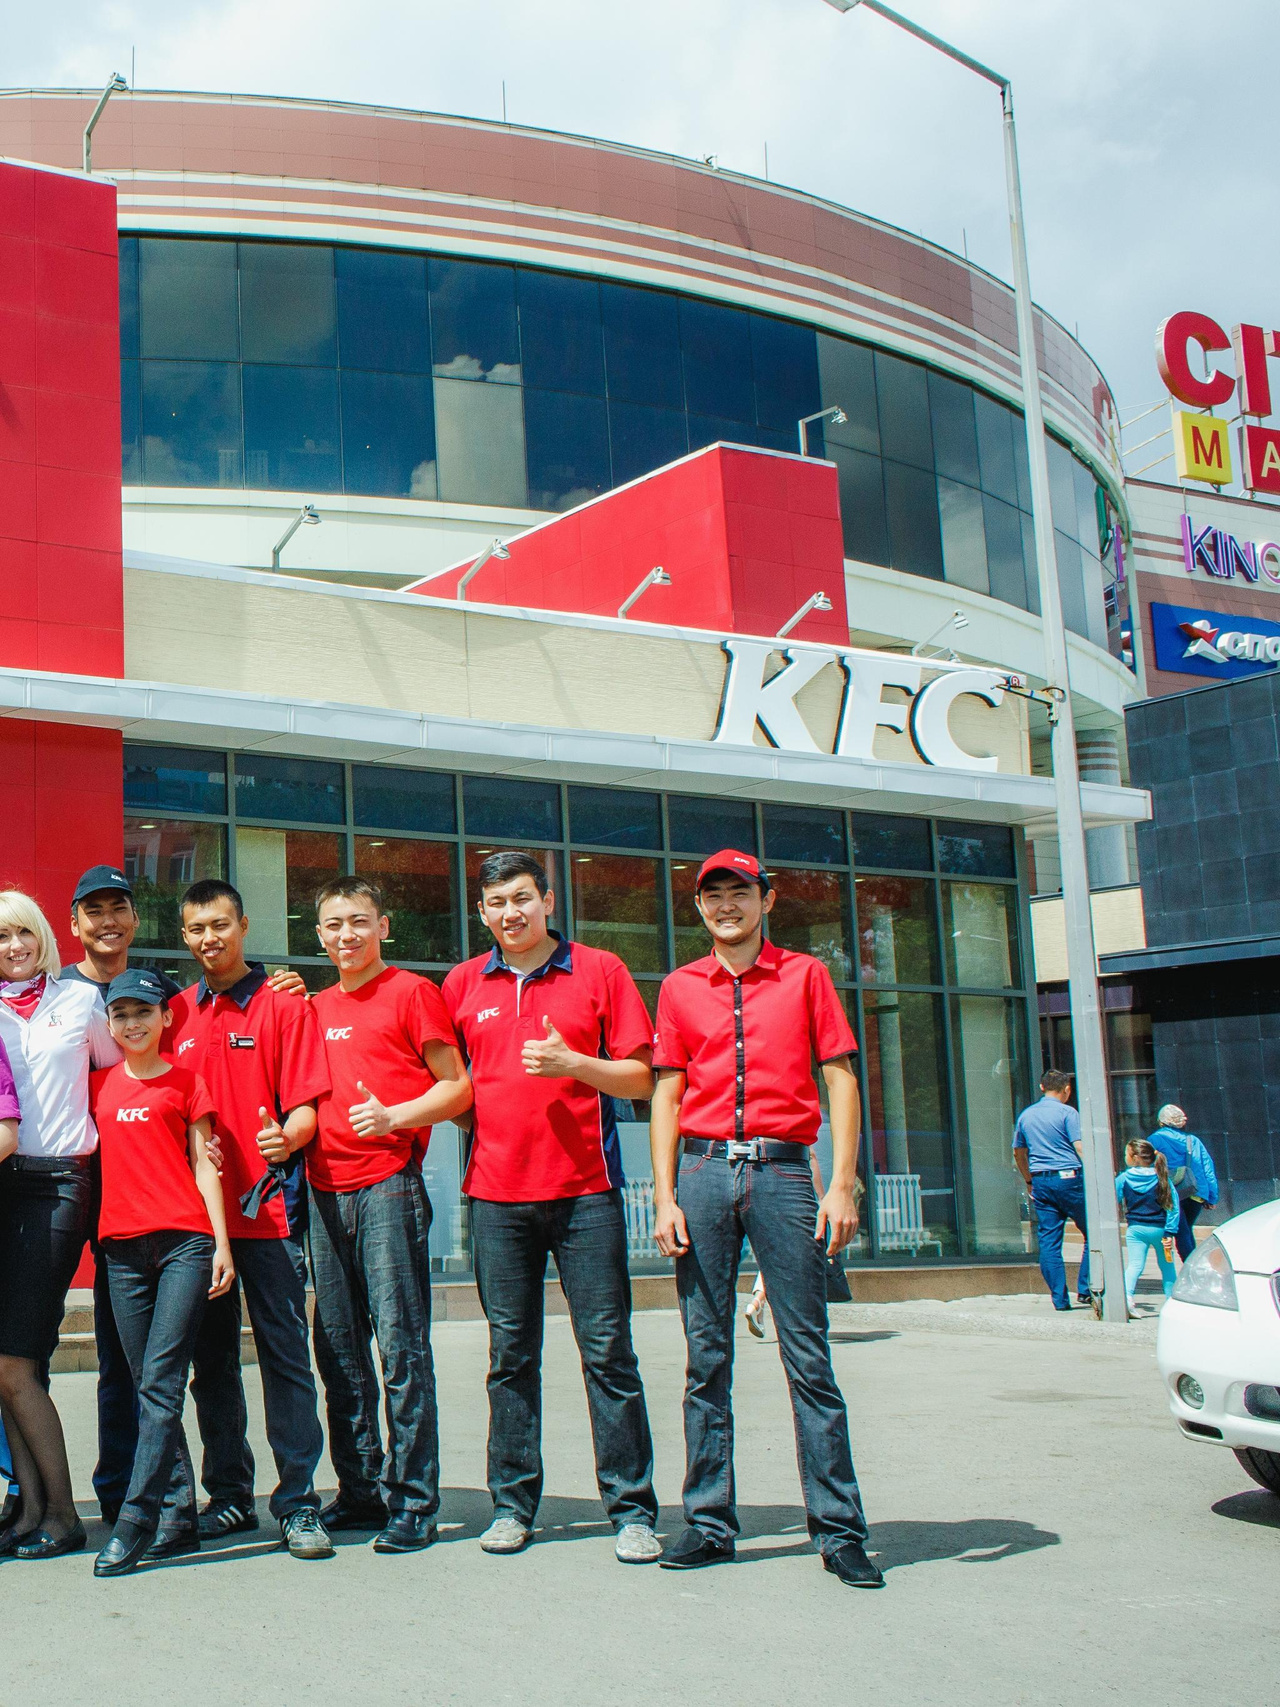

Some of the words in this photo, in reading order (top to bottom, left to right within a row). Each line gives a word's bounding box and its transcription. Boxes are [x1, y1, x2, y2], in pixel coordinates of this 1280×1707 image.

[1154, 311, 1280, 418] CI
[711, 640, 1005, 773] KFC
[476, 1006, 500, 1023] KFC
[325, 1026, 353, 1041] KFC
[177, 1038, 195, 1057] KFC
[116, 1106, 150, 1122] KFC
